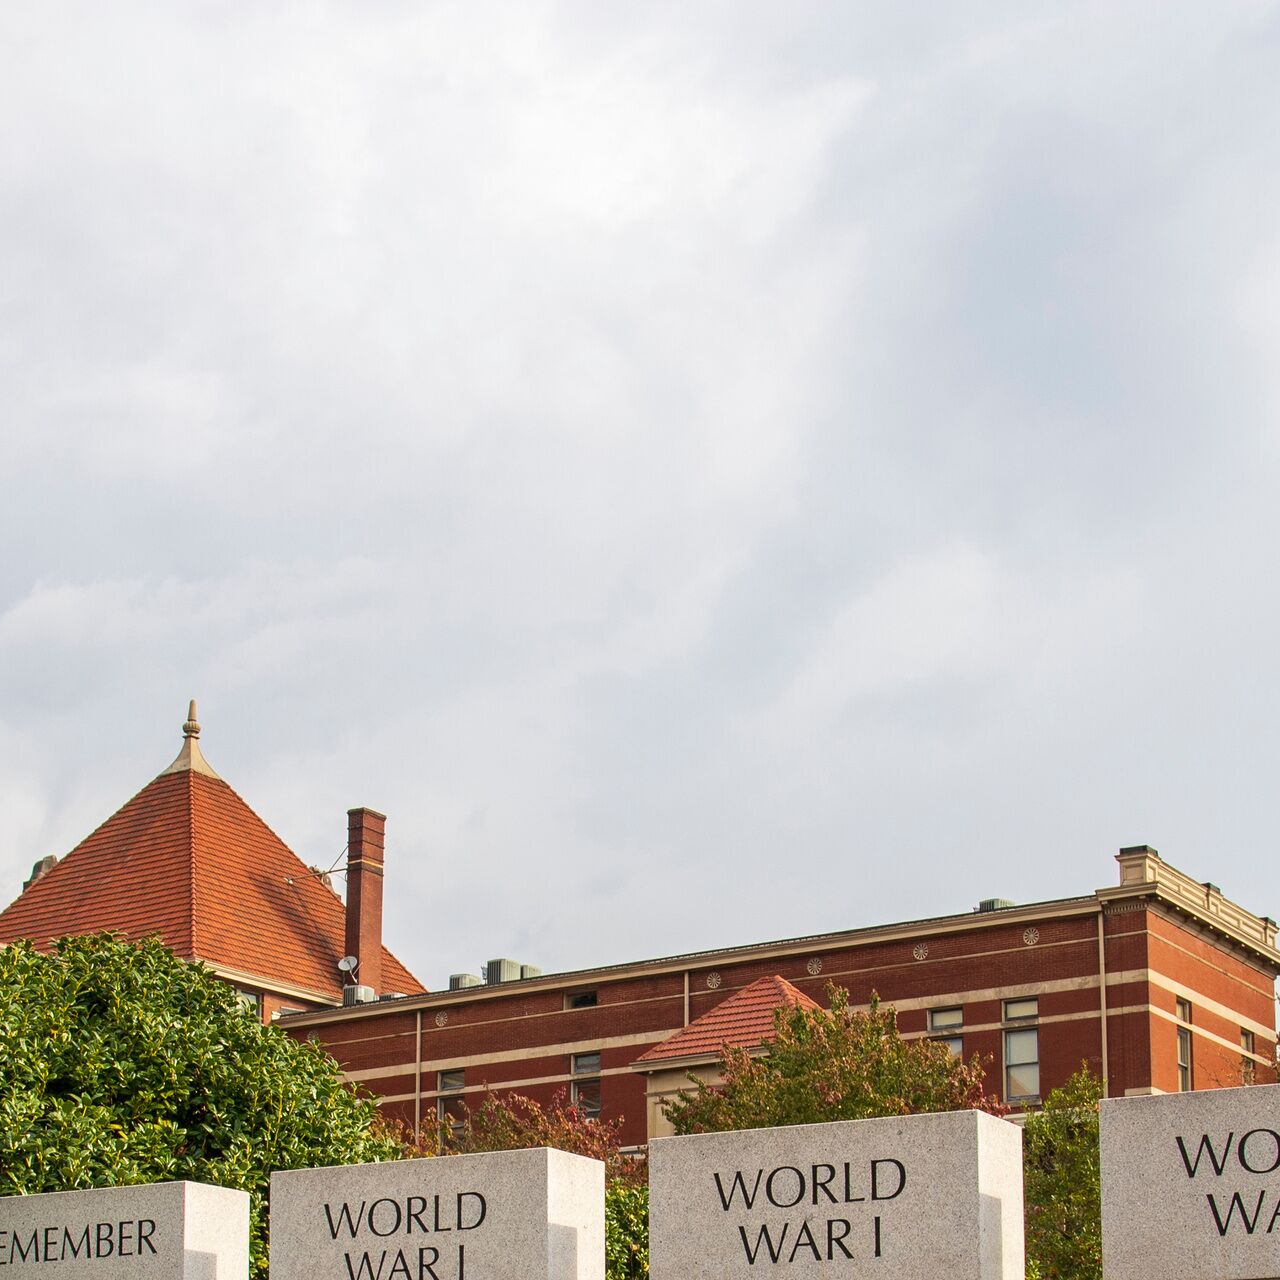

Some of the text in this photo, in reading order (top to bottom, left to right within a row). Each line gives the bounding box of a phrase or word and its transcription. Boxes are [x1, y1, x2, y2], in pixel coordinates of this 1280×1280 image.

[713, 1158, 907, 1212] WORLD
[324, 1191, 487, 1240] WORLD
[738, 1216, 882, 1265] WAR I
